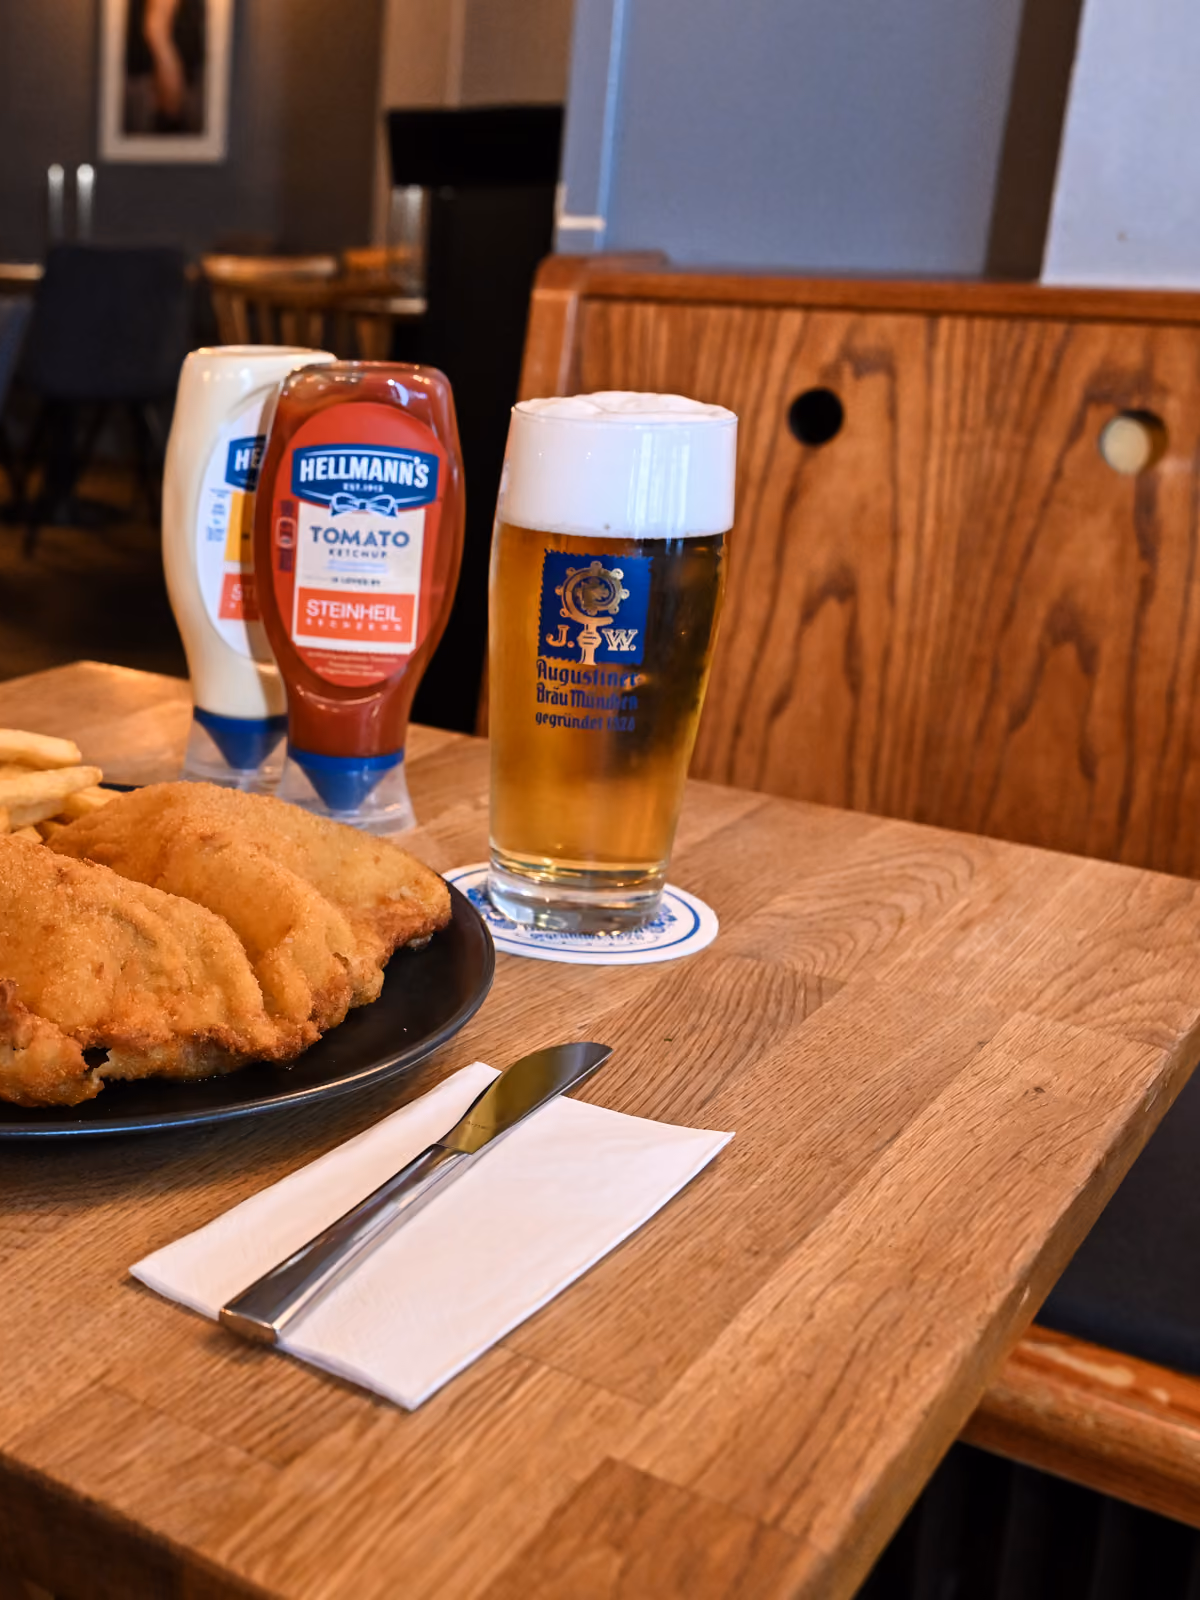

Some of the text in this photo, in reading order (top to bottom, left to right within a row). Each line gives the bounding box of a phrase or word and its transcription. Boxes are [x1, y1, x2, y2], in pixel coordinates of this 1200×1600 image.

[300, 456, 430, 488] HELLMANN'S
[310, 526, 410, 548] TOMATO
[329, 549, 387, 559] KETCHUP
[306, 598, 402, 623] STEINHEIL
[536, 659, 640, 687] Augustiner
[536, 682, 638, 711] Bräu München
[535, 711, 603, 730] gegründet
